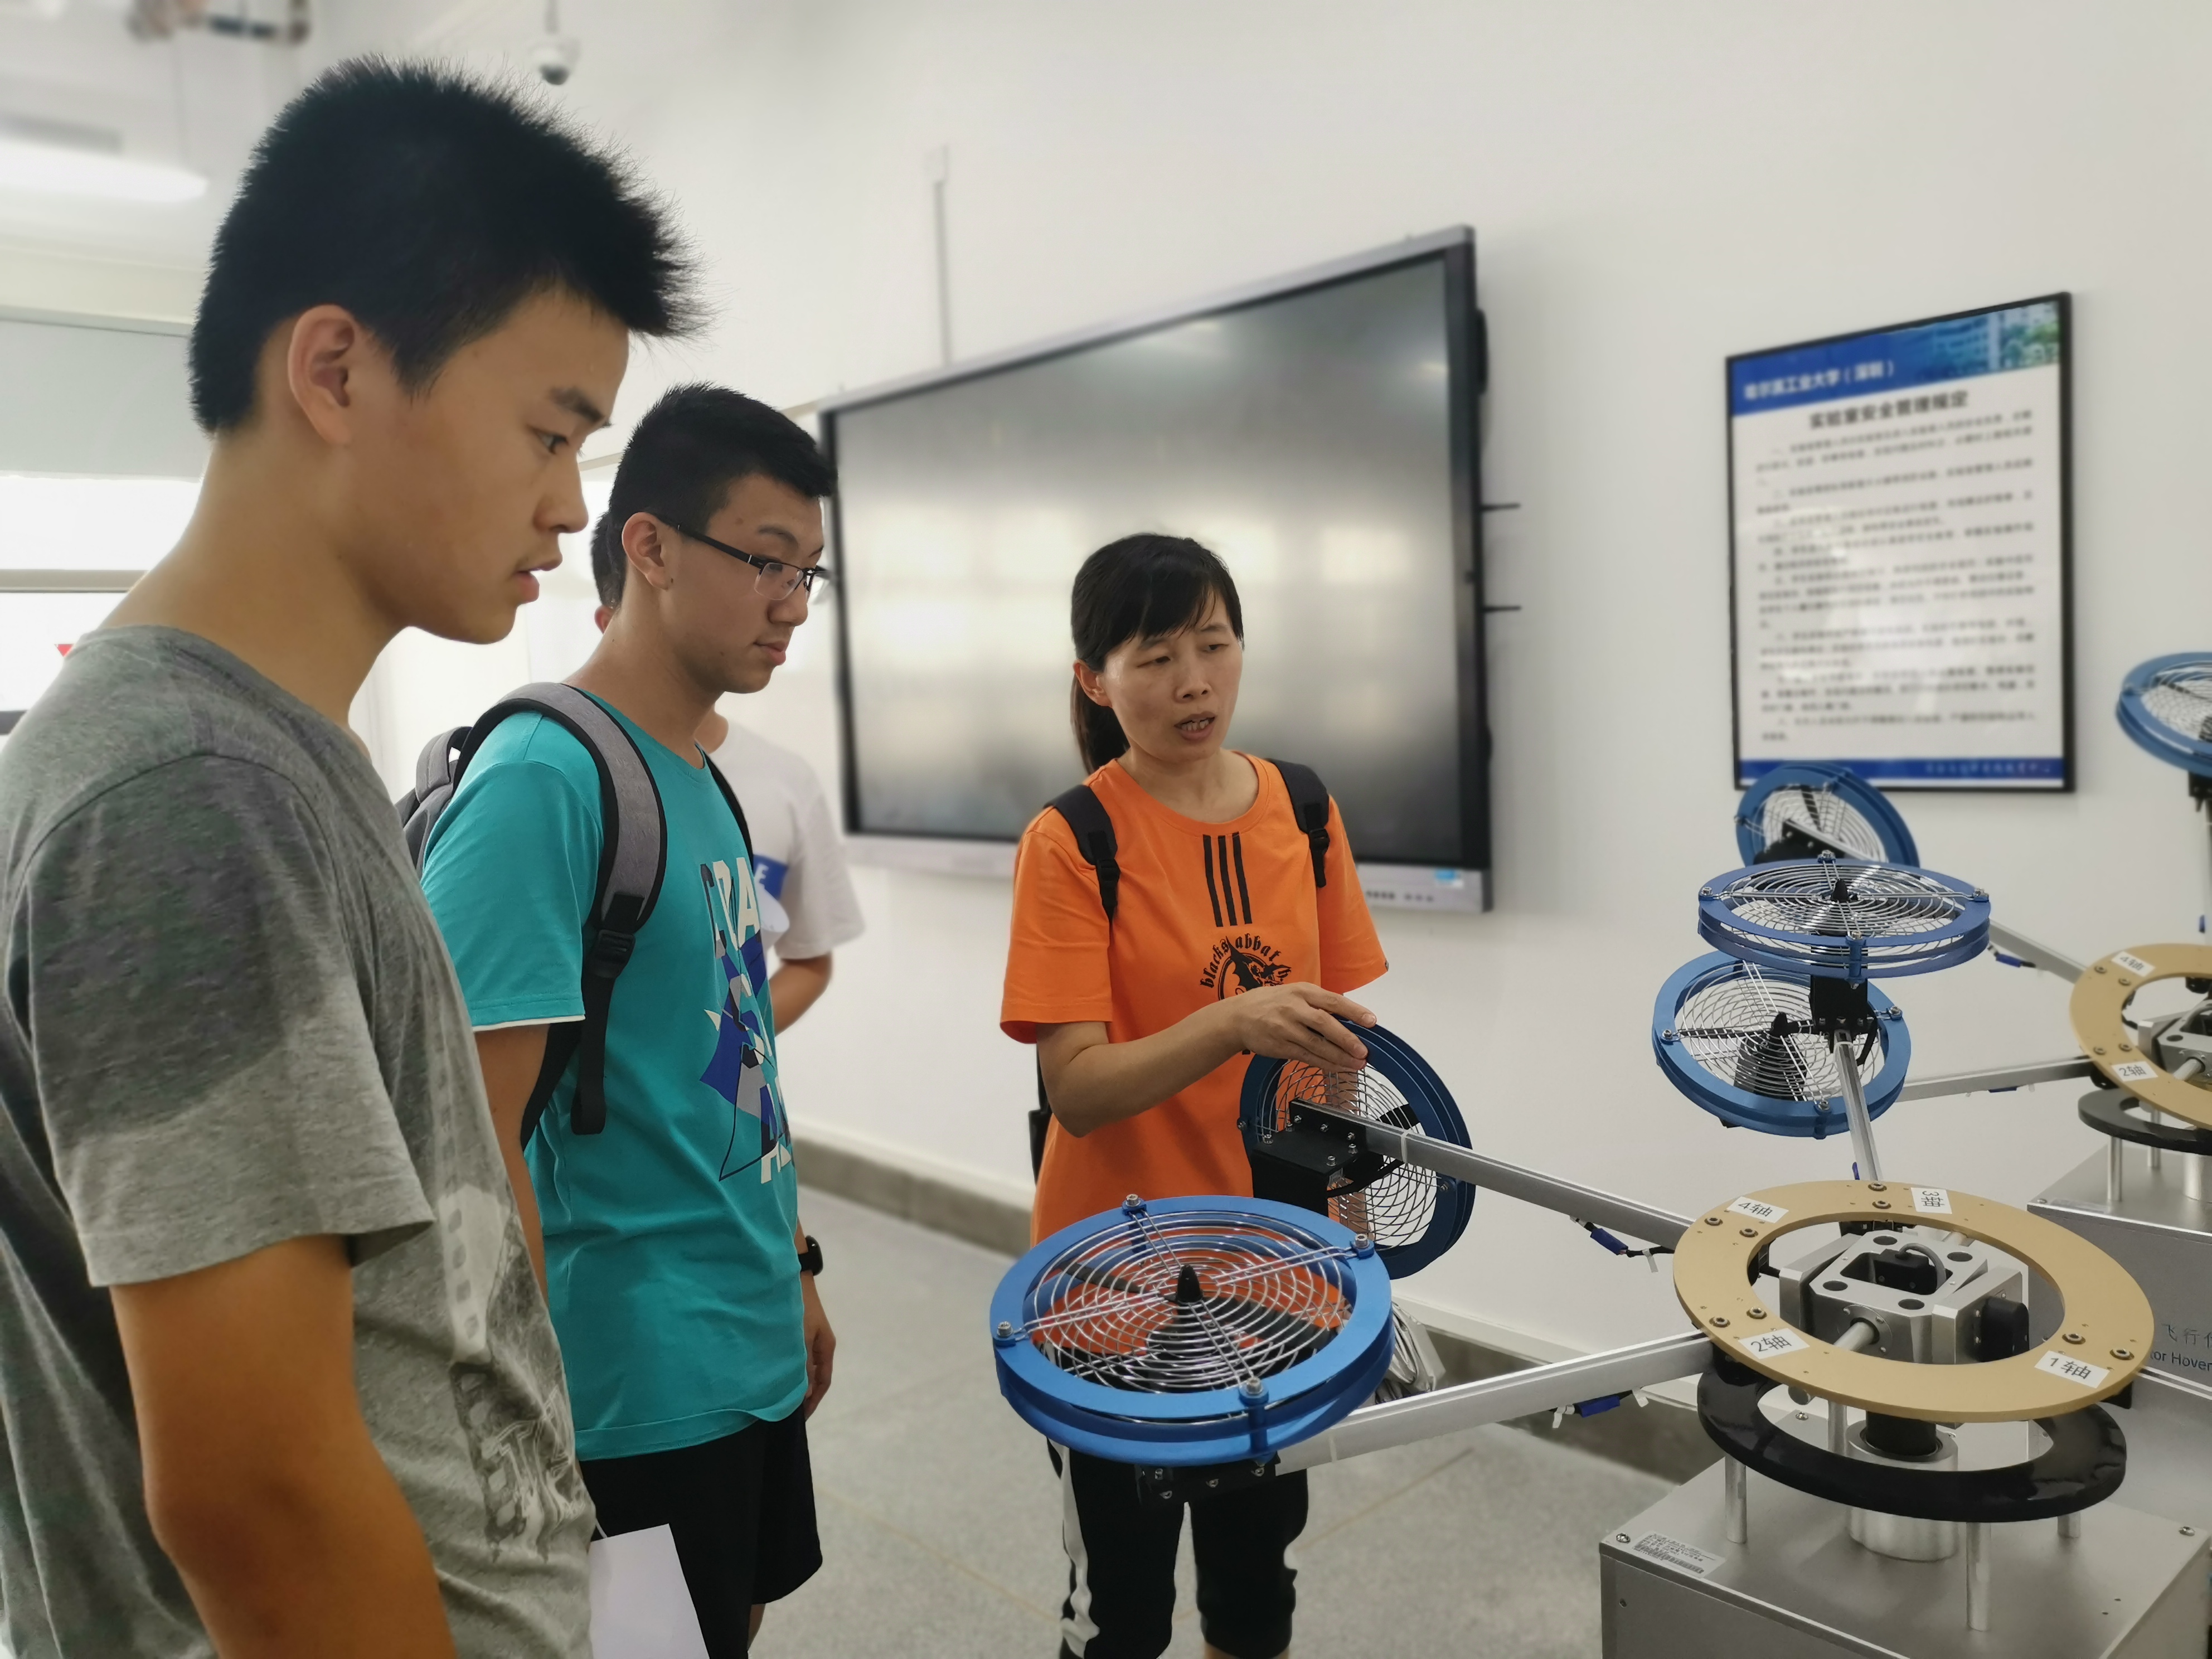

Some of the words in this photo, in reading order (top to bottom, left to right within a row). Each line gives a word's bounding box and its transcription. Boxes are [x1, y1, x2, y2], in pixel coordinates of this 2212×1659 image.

[2119, 1065, 2146, 1076] 2轴
[1921, 1191, 1945, 1207] 3轴
[1738, 1202, 1773, 1216] 4轴
[1751, 1335, 1792, 1352] 2轴
